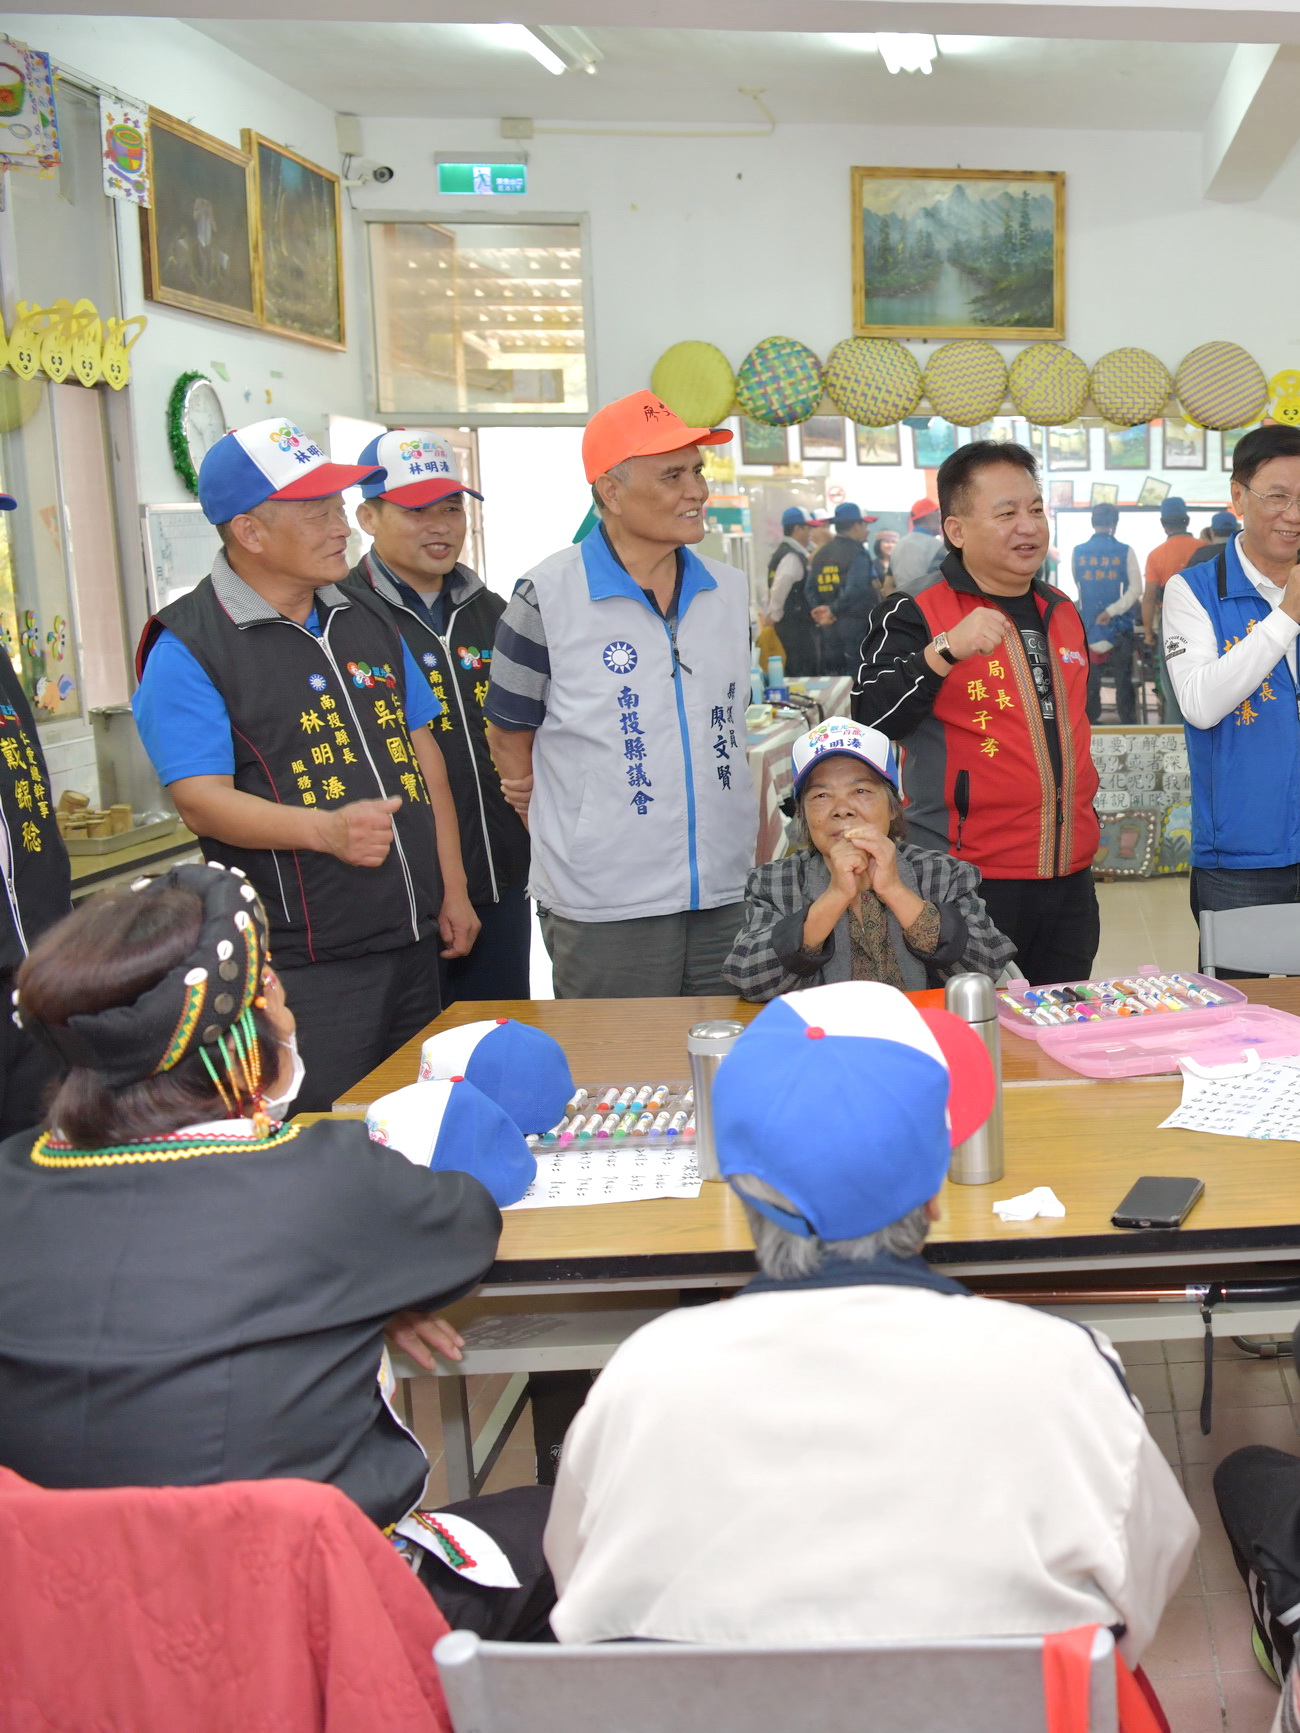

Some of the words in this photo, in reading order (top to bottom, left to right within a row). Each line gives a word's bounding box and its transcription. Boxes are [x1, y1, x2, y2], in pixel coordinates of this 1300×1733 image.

[294, 444, 325, 464] 林明
[727, 682, 738, 748] 縣議員
[967, 679, 999, 757] 張子孝
[988, 660, 1014, 710] 局長
[300, 709, 346, 800] 林明溱
[319, 694, 358, 765] 南投縣長
[374, 699, 421, 803] 吳國寶
[617, 686, 654, 815] 南投縣議會
[711, 706, 731, 791] 廖文賢
[291, 759, 318, 811] 服務團
